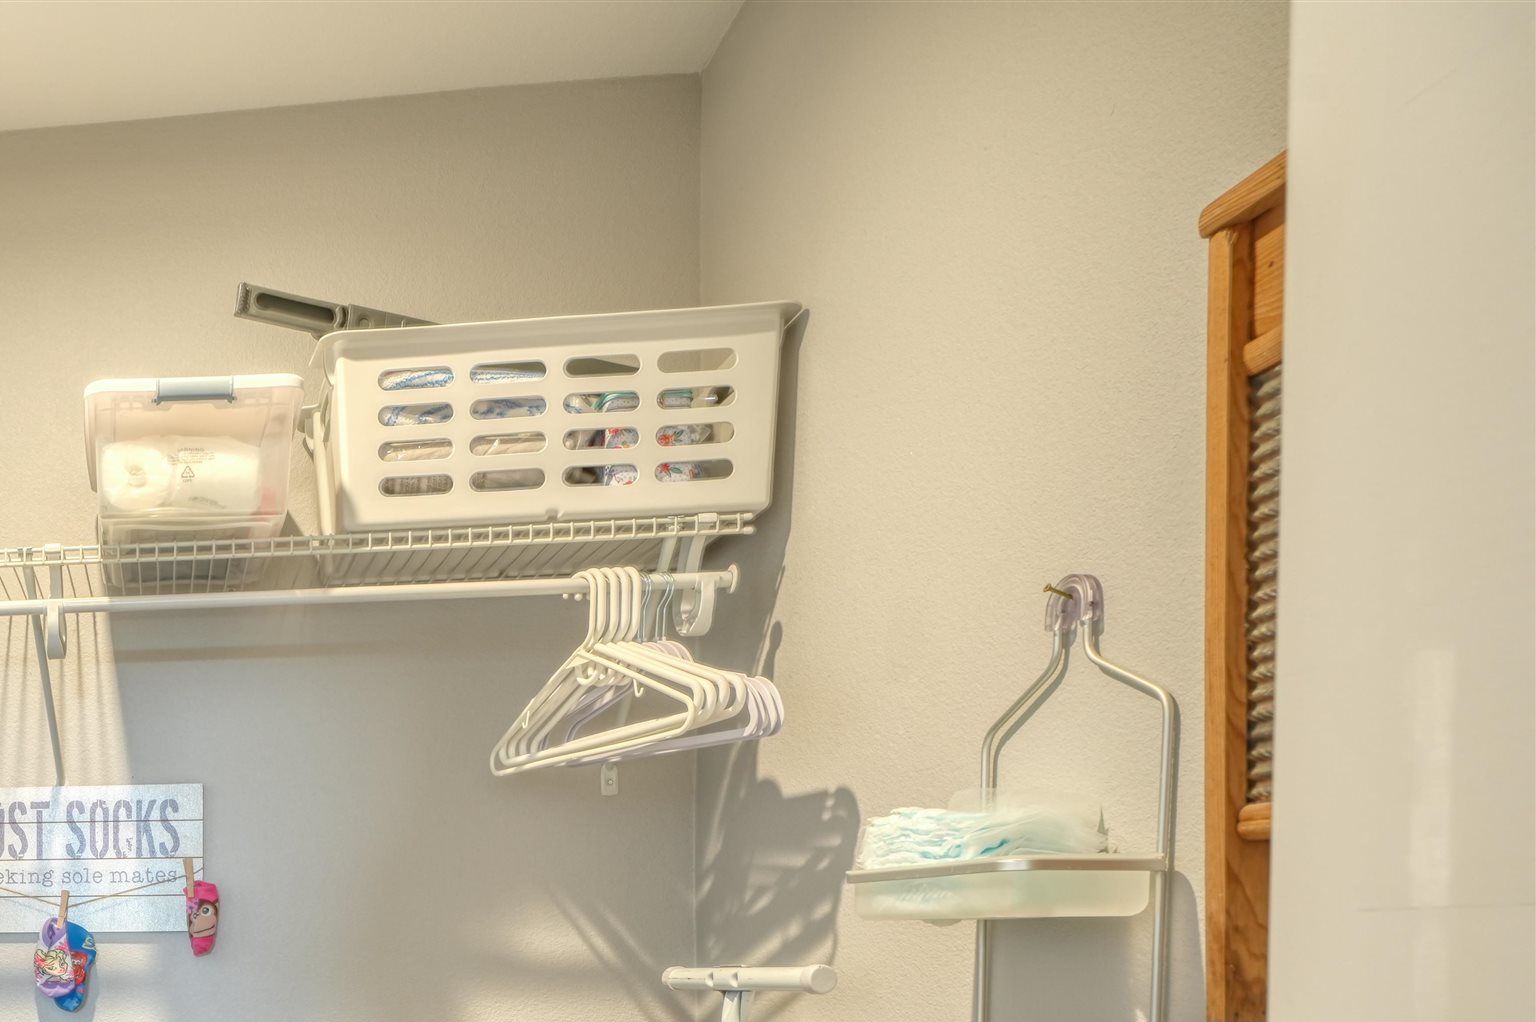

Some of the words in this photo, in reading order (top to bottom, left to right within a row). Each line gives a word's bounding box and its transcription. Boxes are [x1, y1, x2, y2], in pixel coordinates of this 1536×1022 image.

[65, 798, 180, 859] SOCKS
[61, 867, 103, 884] sole
[109, 867, 178, 884] mates
